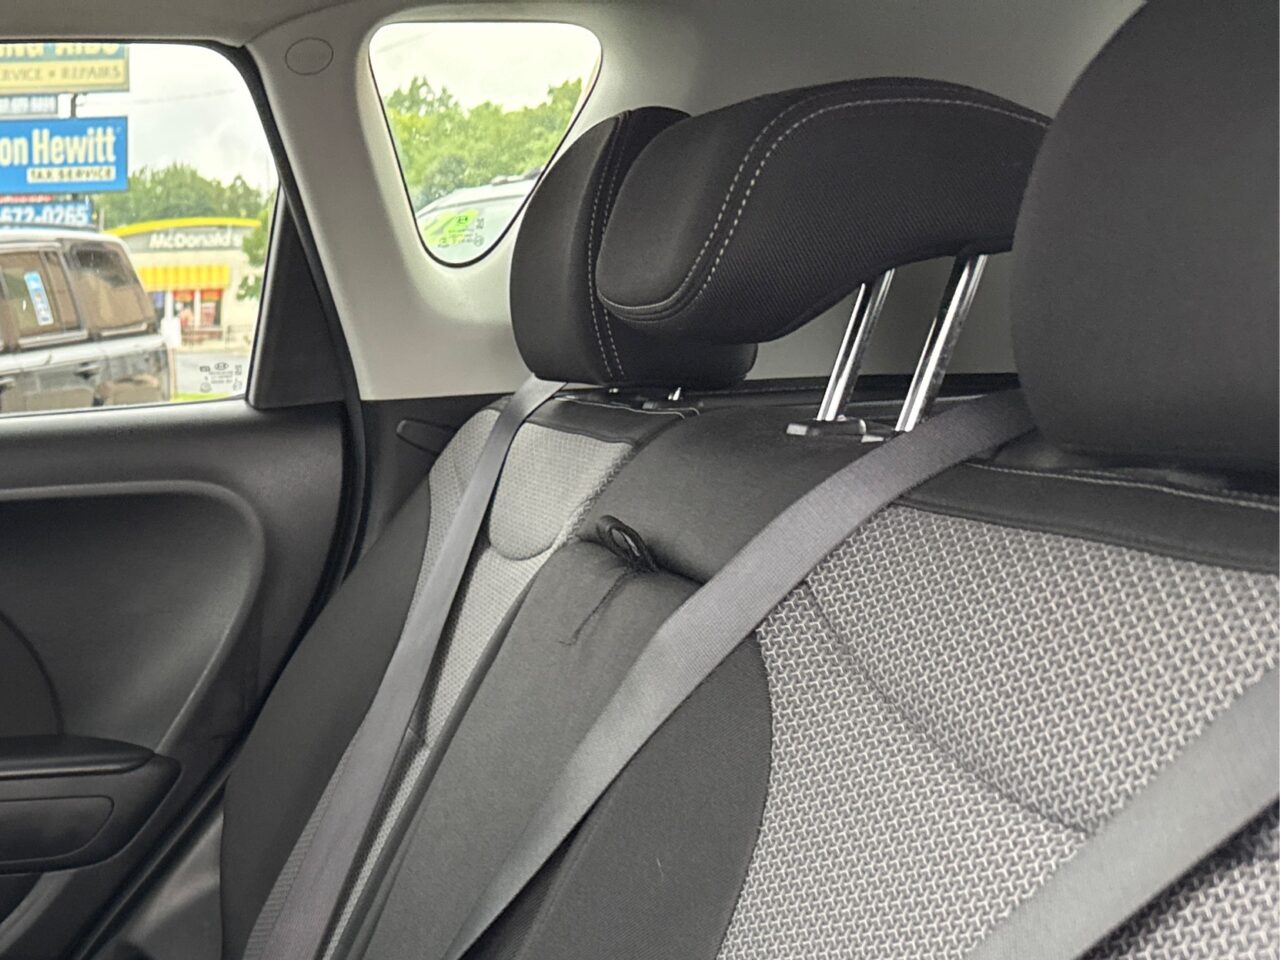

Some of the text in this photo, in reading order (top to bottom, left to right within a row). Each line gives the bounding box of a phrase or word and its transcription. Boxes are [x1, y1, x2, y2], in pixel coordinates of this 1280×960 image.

[60, 65, 121, 80] REPAIRS
[32, 125, 117, 165] Hewitt
[30, 167, 112, 181] TAX SERVICE
